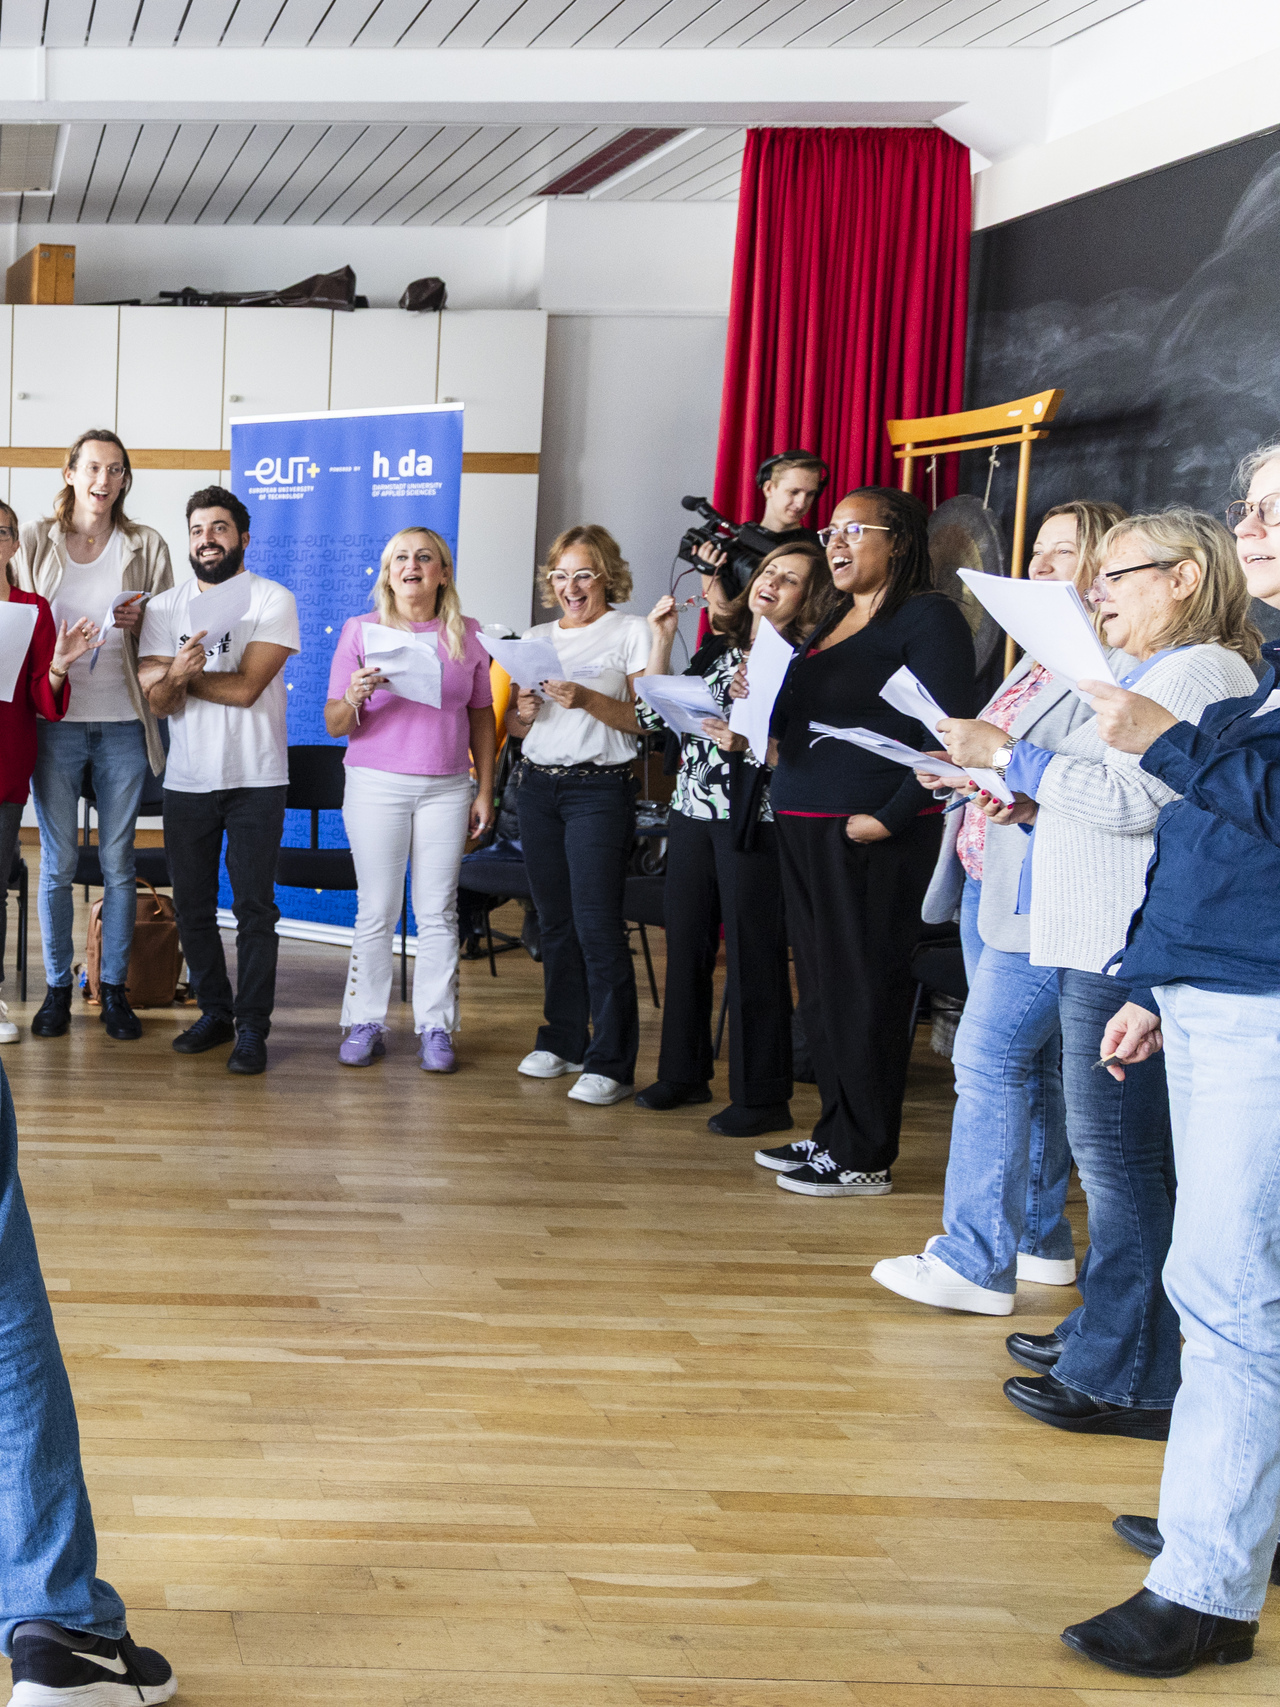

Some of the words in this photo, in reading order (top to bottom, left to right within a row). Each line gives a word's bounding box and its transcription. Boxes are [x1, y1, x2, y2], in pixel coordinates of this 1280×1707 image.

[372, 448, 433, 481] h_da
[248, 486, 277, 494] EUROPEAN
[278, 485, 315, 493] UNIVERSITY
[381, 489, 406, 497] APPLIED
[406, 488, 437, 496] SCIENCES
